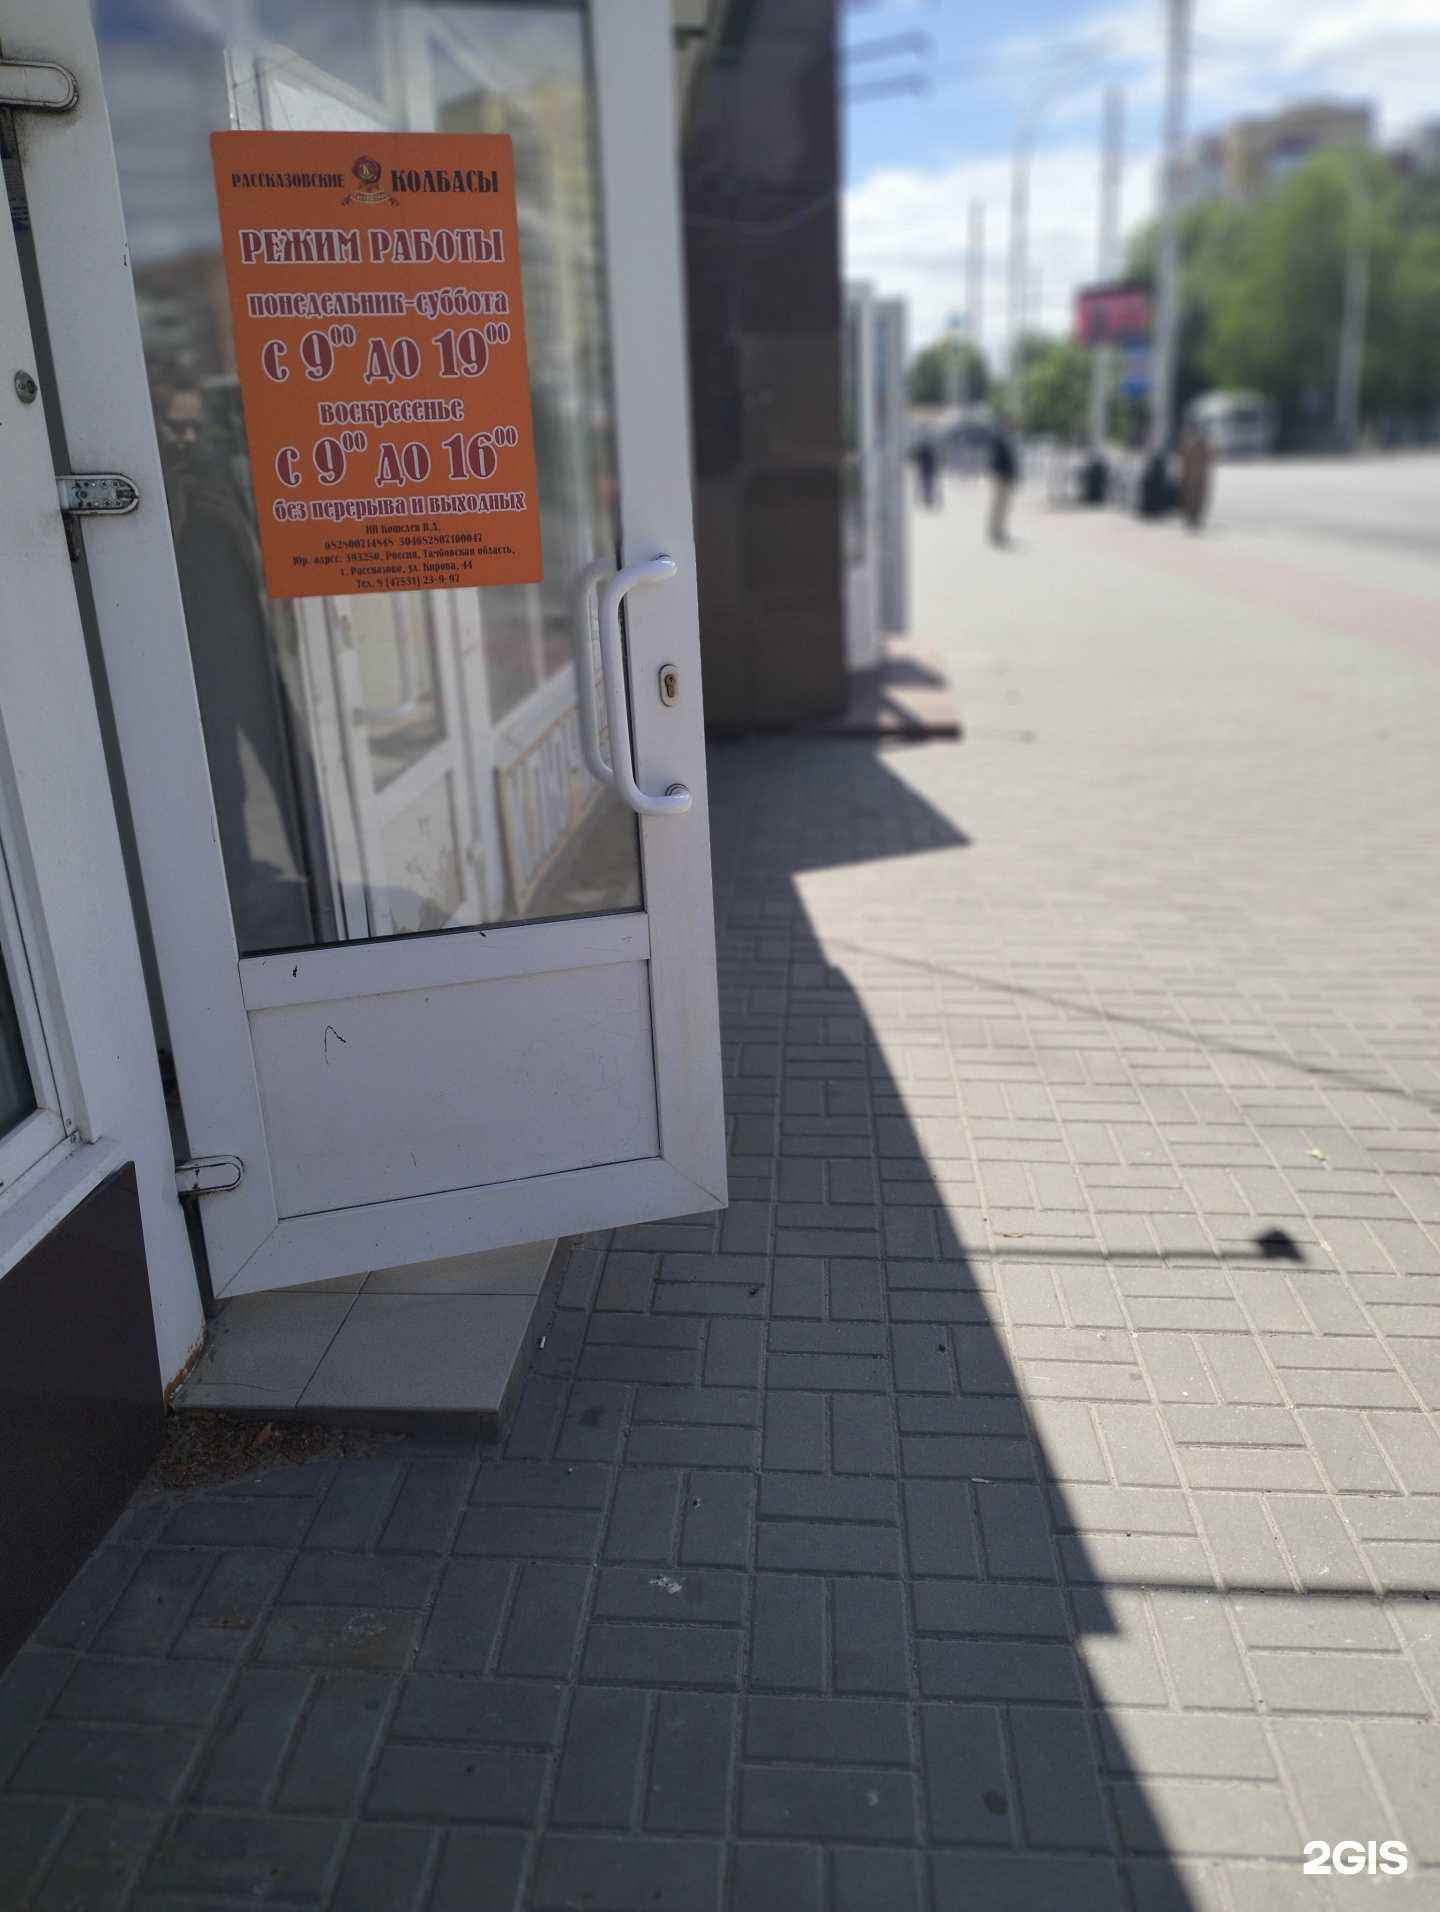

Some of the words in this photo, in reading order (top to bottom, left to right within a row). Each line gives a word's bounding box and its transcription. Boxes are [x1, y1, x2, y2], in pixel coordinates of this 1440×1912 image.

[231, 172, 345, 188] РАССКАЗОВСКИЕ
[390, 168, 499, 193] КОЛБАСЫ
[239, 229, 361, 264] РЕЖИМ
[368, 228, 505, 263] РАБОТЫ
[318, 398, 465, 427] воскресенье
[273, 498, 306, 522] без
[310, 495, 406, 521] перерыва
[411, 496, 425, 515] и
[429, 490, 527, 514] выходных
